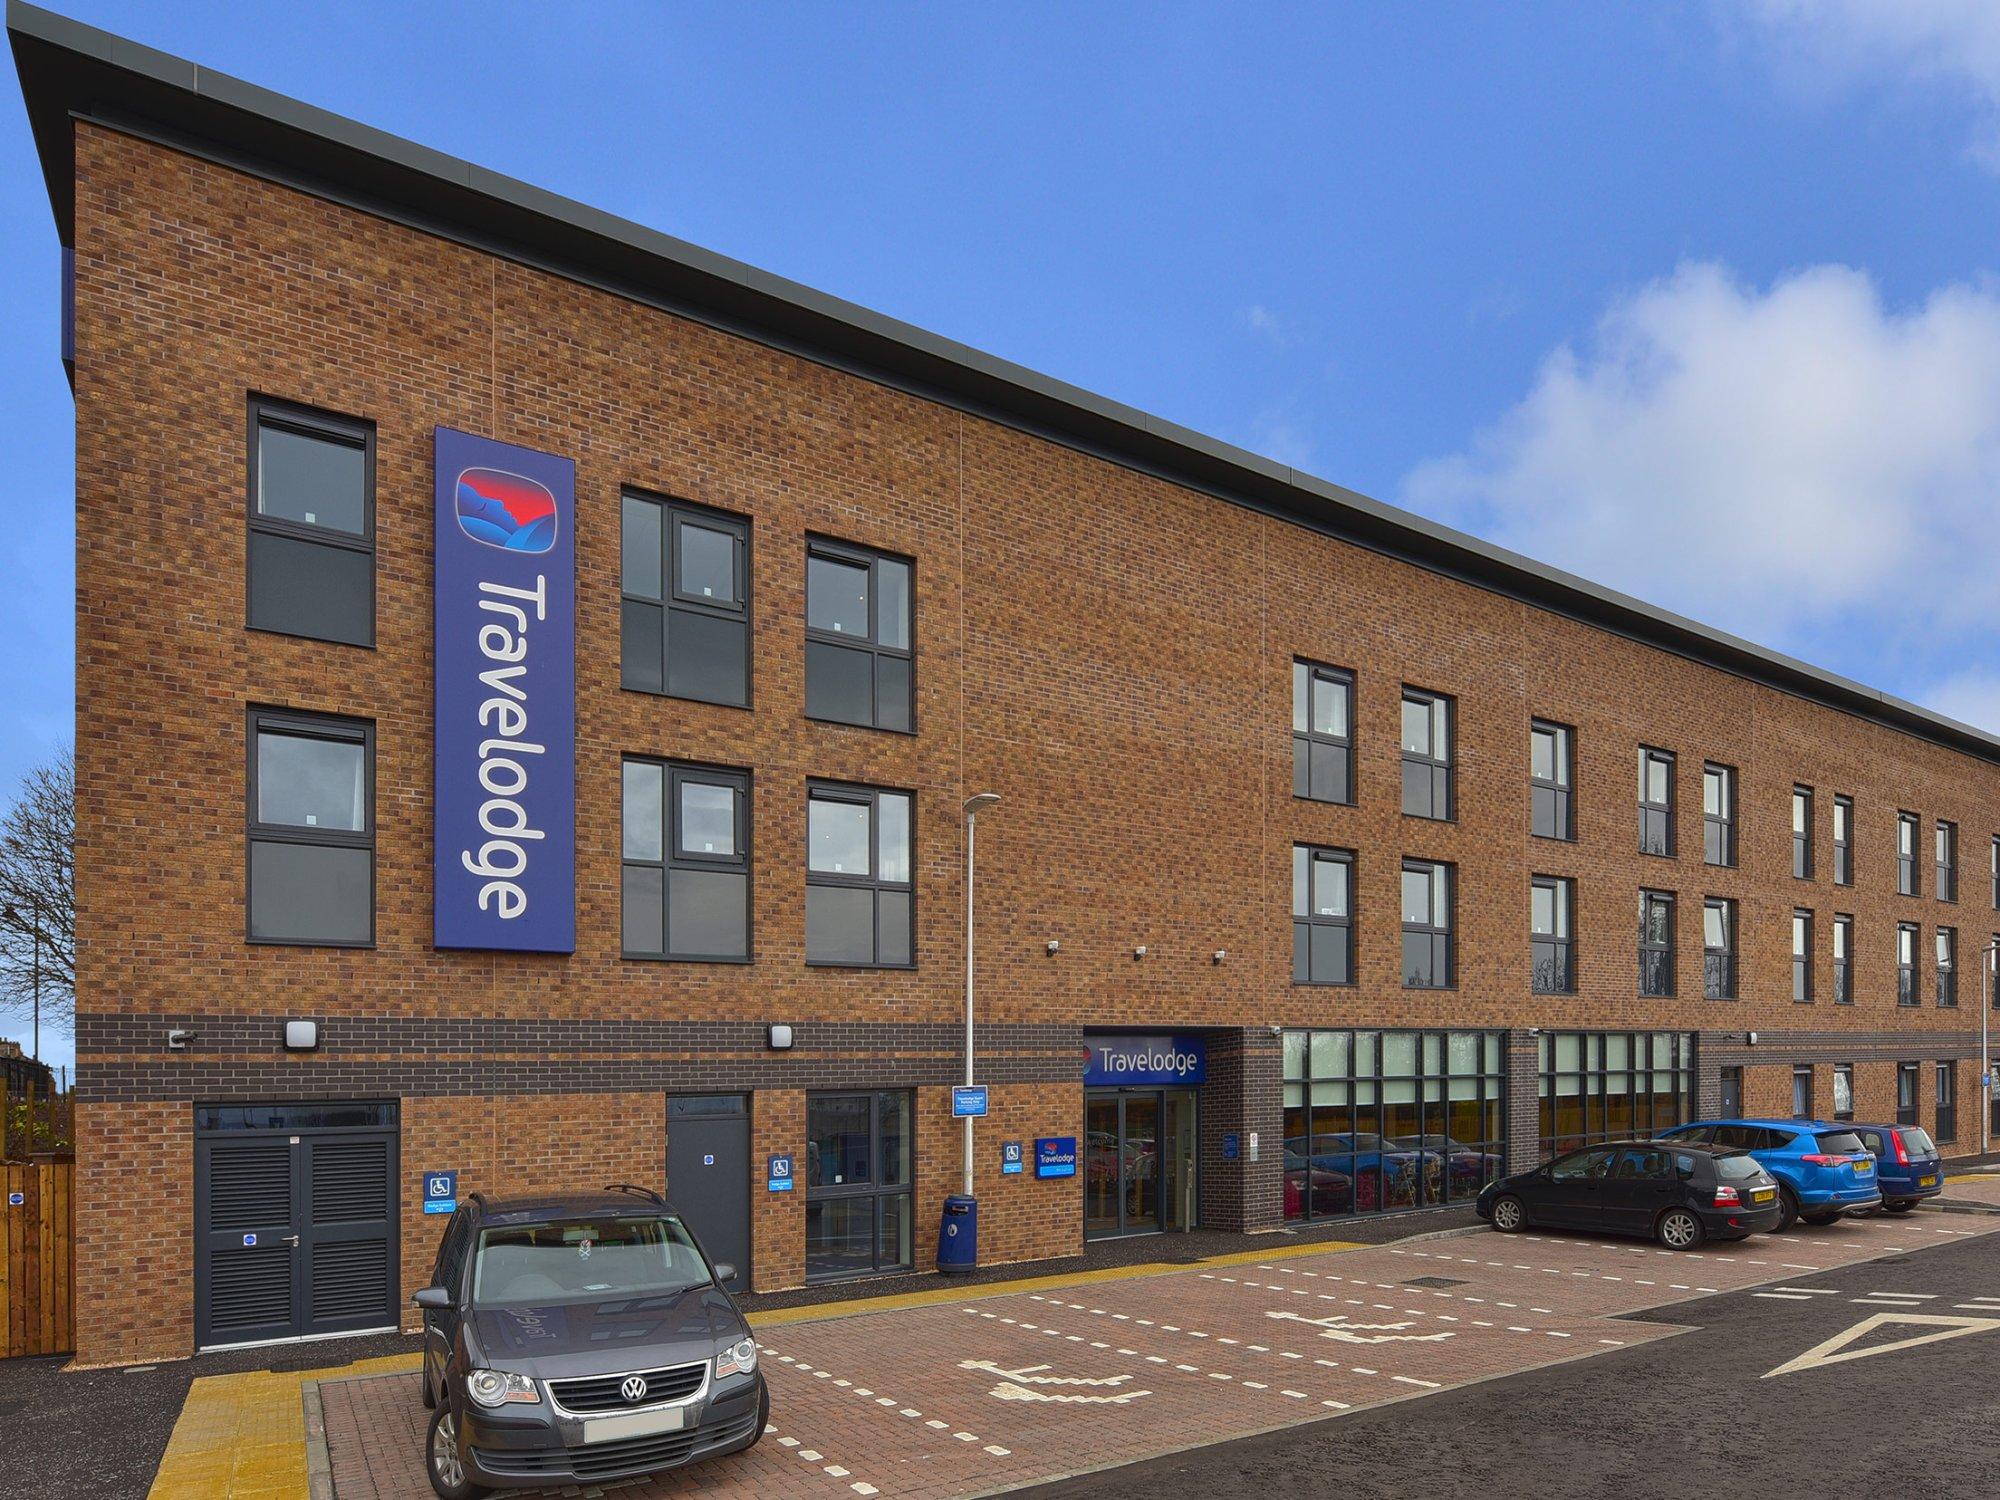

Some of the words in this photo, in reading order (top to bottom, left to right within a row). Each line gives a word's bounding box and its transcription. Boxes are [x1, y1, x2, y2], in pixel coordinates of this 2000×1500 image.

[462, 575, 546, 919] Travelodge
[1099, 1047, 1197, 1076] Travelodge
[1039, 1153, 1075, 1164] Travelodge
